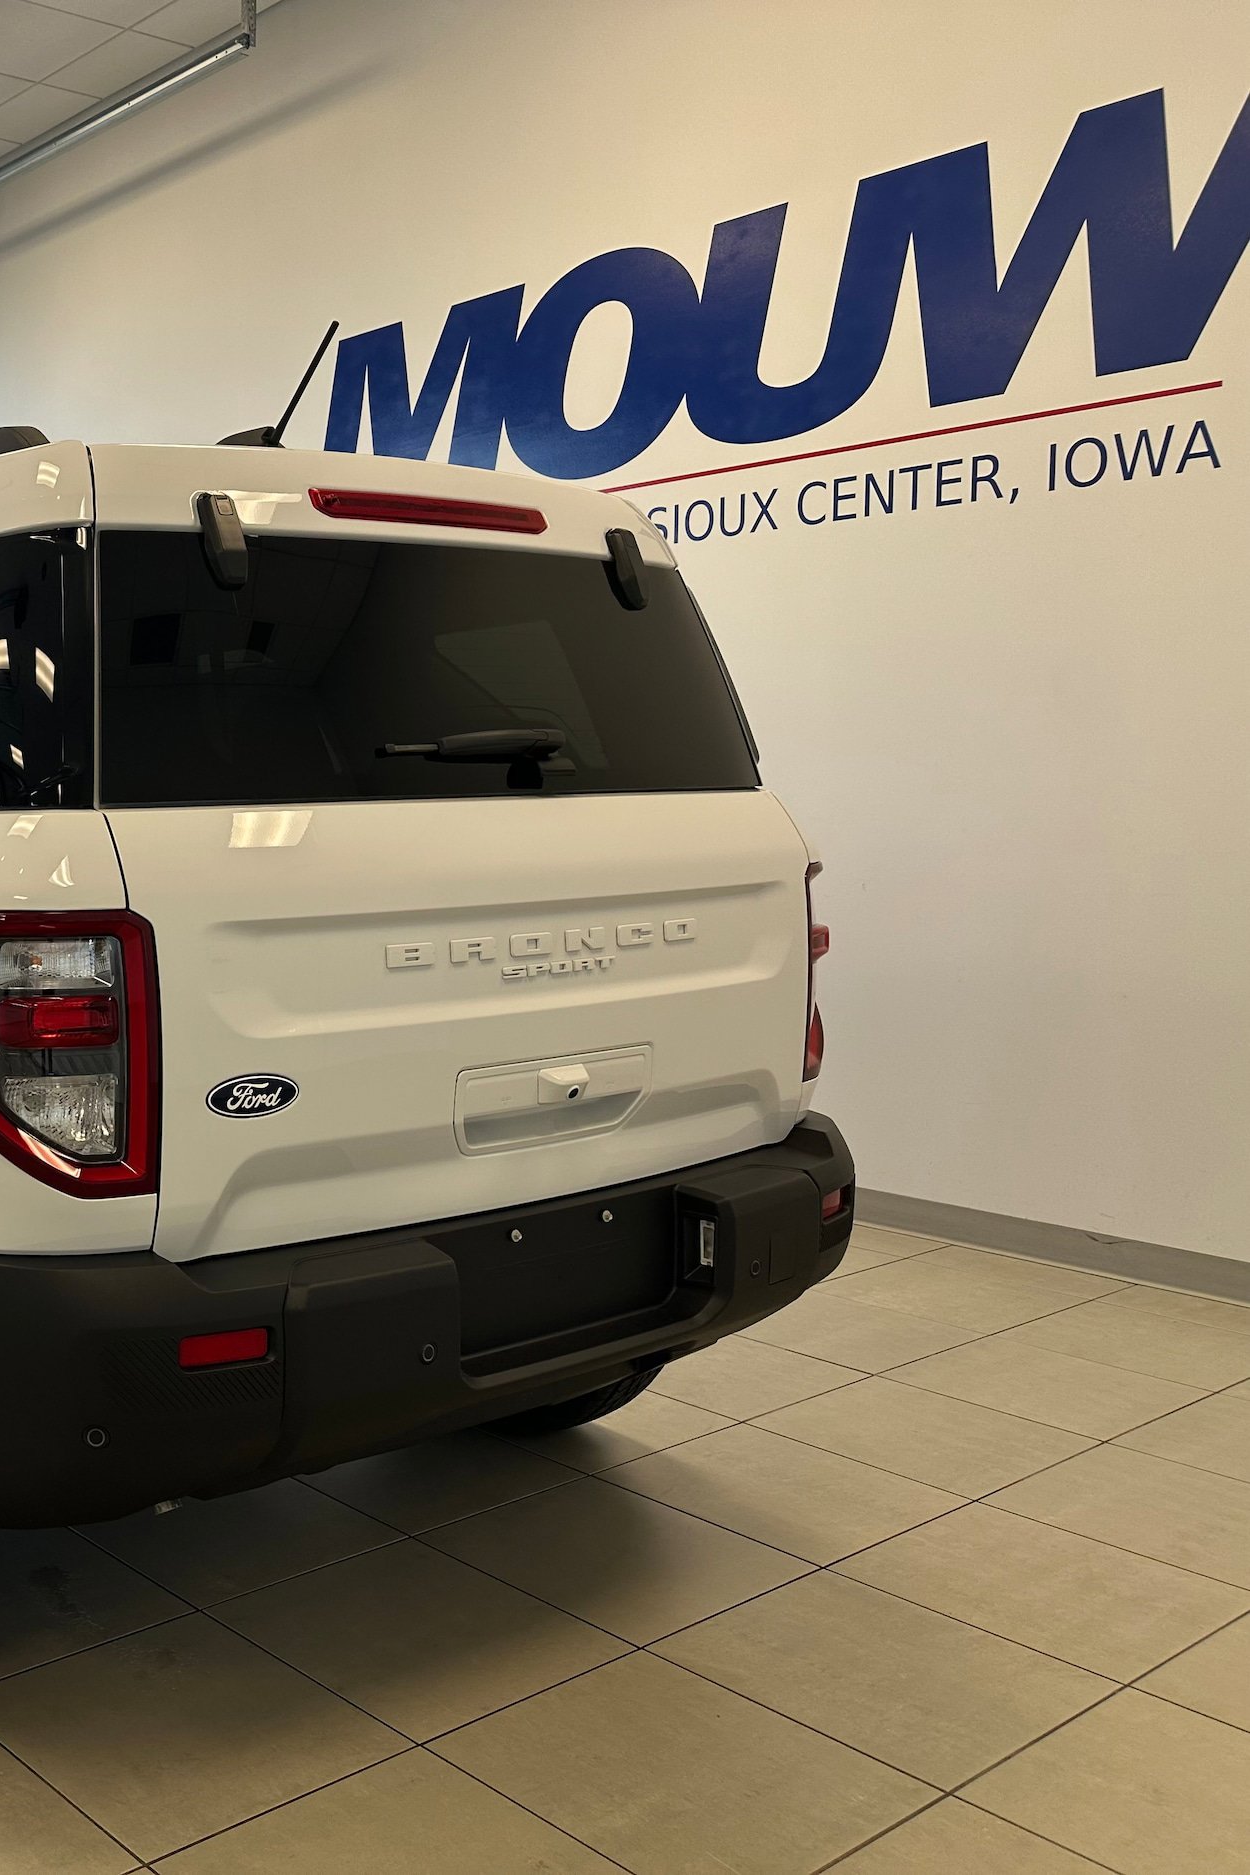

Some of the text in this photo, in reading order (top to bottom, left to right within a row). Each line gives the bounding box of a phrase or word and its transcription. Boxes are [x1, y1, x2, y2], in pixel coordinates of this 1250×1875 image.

[325, 87, 1250, 479] MOUW
[648, 420, 1221, 543] SIOUX CENTER, IOWA
[386, 918, 697, 968] BRONCO
[501, 955, 616, 979] SPORT
[226, 1082, 283, 1110] Ford
